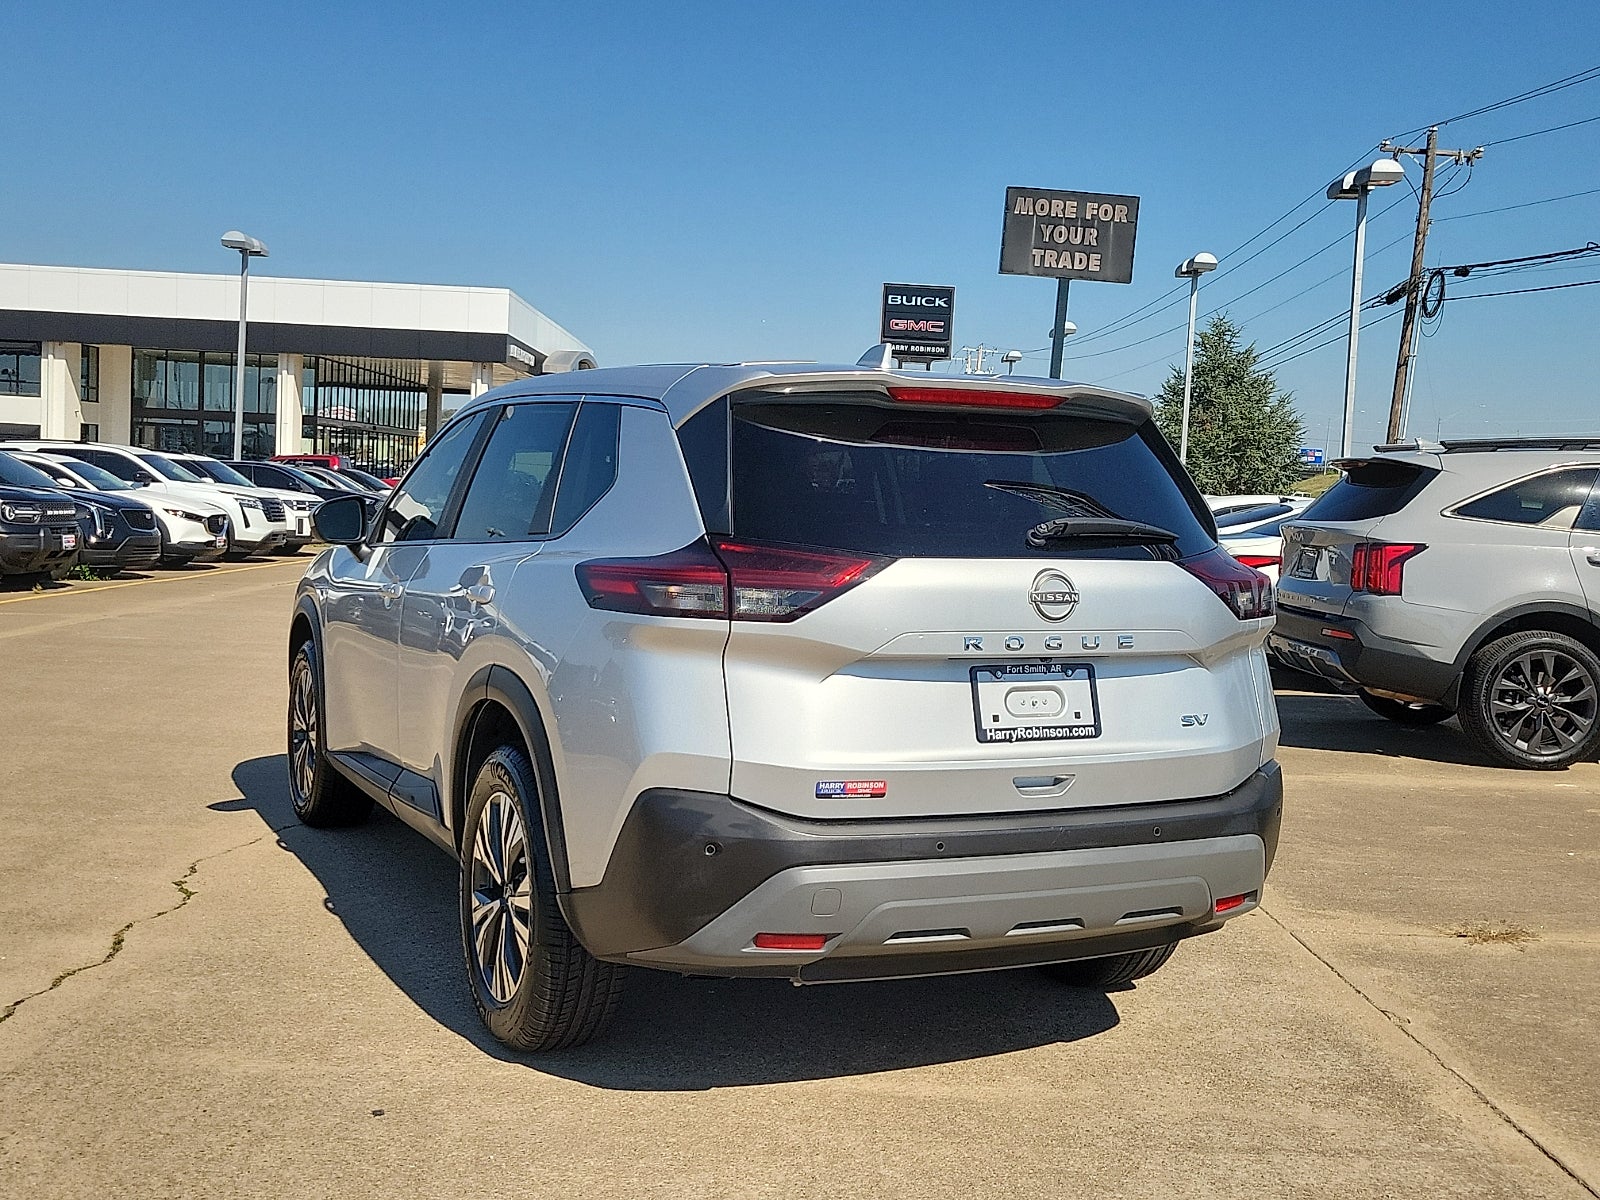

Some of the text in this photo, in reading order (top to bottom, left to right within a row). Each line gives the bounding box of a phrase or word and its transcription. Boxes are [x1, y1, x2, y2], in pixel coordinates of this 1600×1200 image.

[1014, 197, 1128, 222] MORE FOR
[1040, 224, 1098, 246] YOUR
[1032, 249, 1101, 271] TRADE
[888, 295, 949, 307] BUICK
[890, 319, 944, 332] GMC
[1032, 592, 1079, 602] NISSAN
[963, 635, 1135, 651] ROGUE
[1006, 665, 1062, 674] Fort Smith, AR
[1180, 713, 1208, 727] SV
[986, 726, 1096, 741] HarryRobinson.com
[847, 781, 884, 789] ROBINSON
